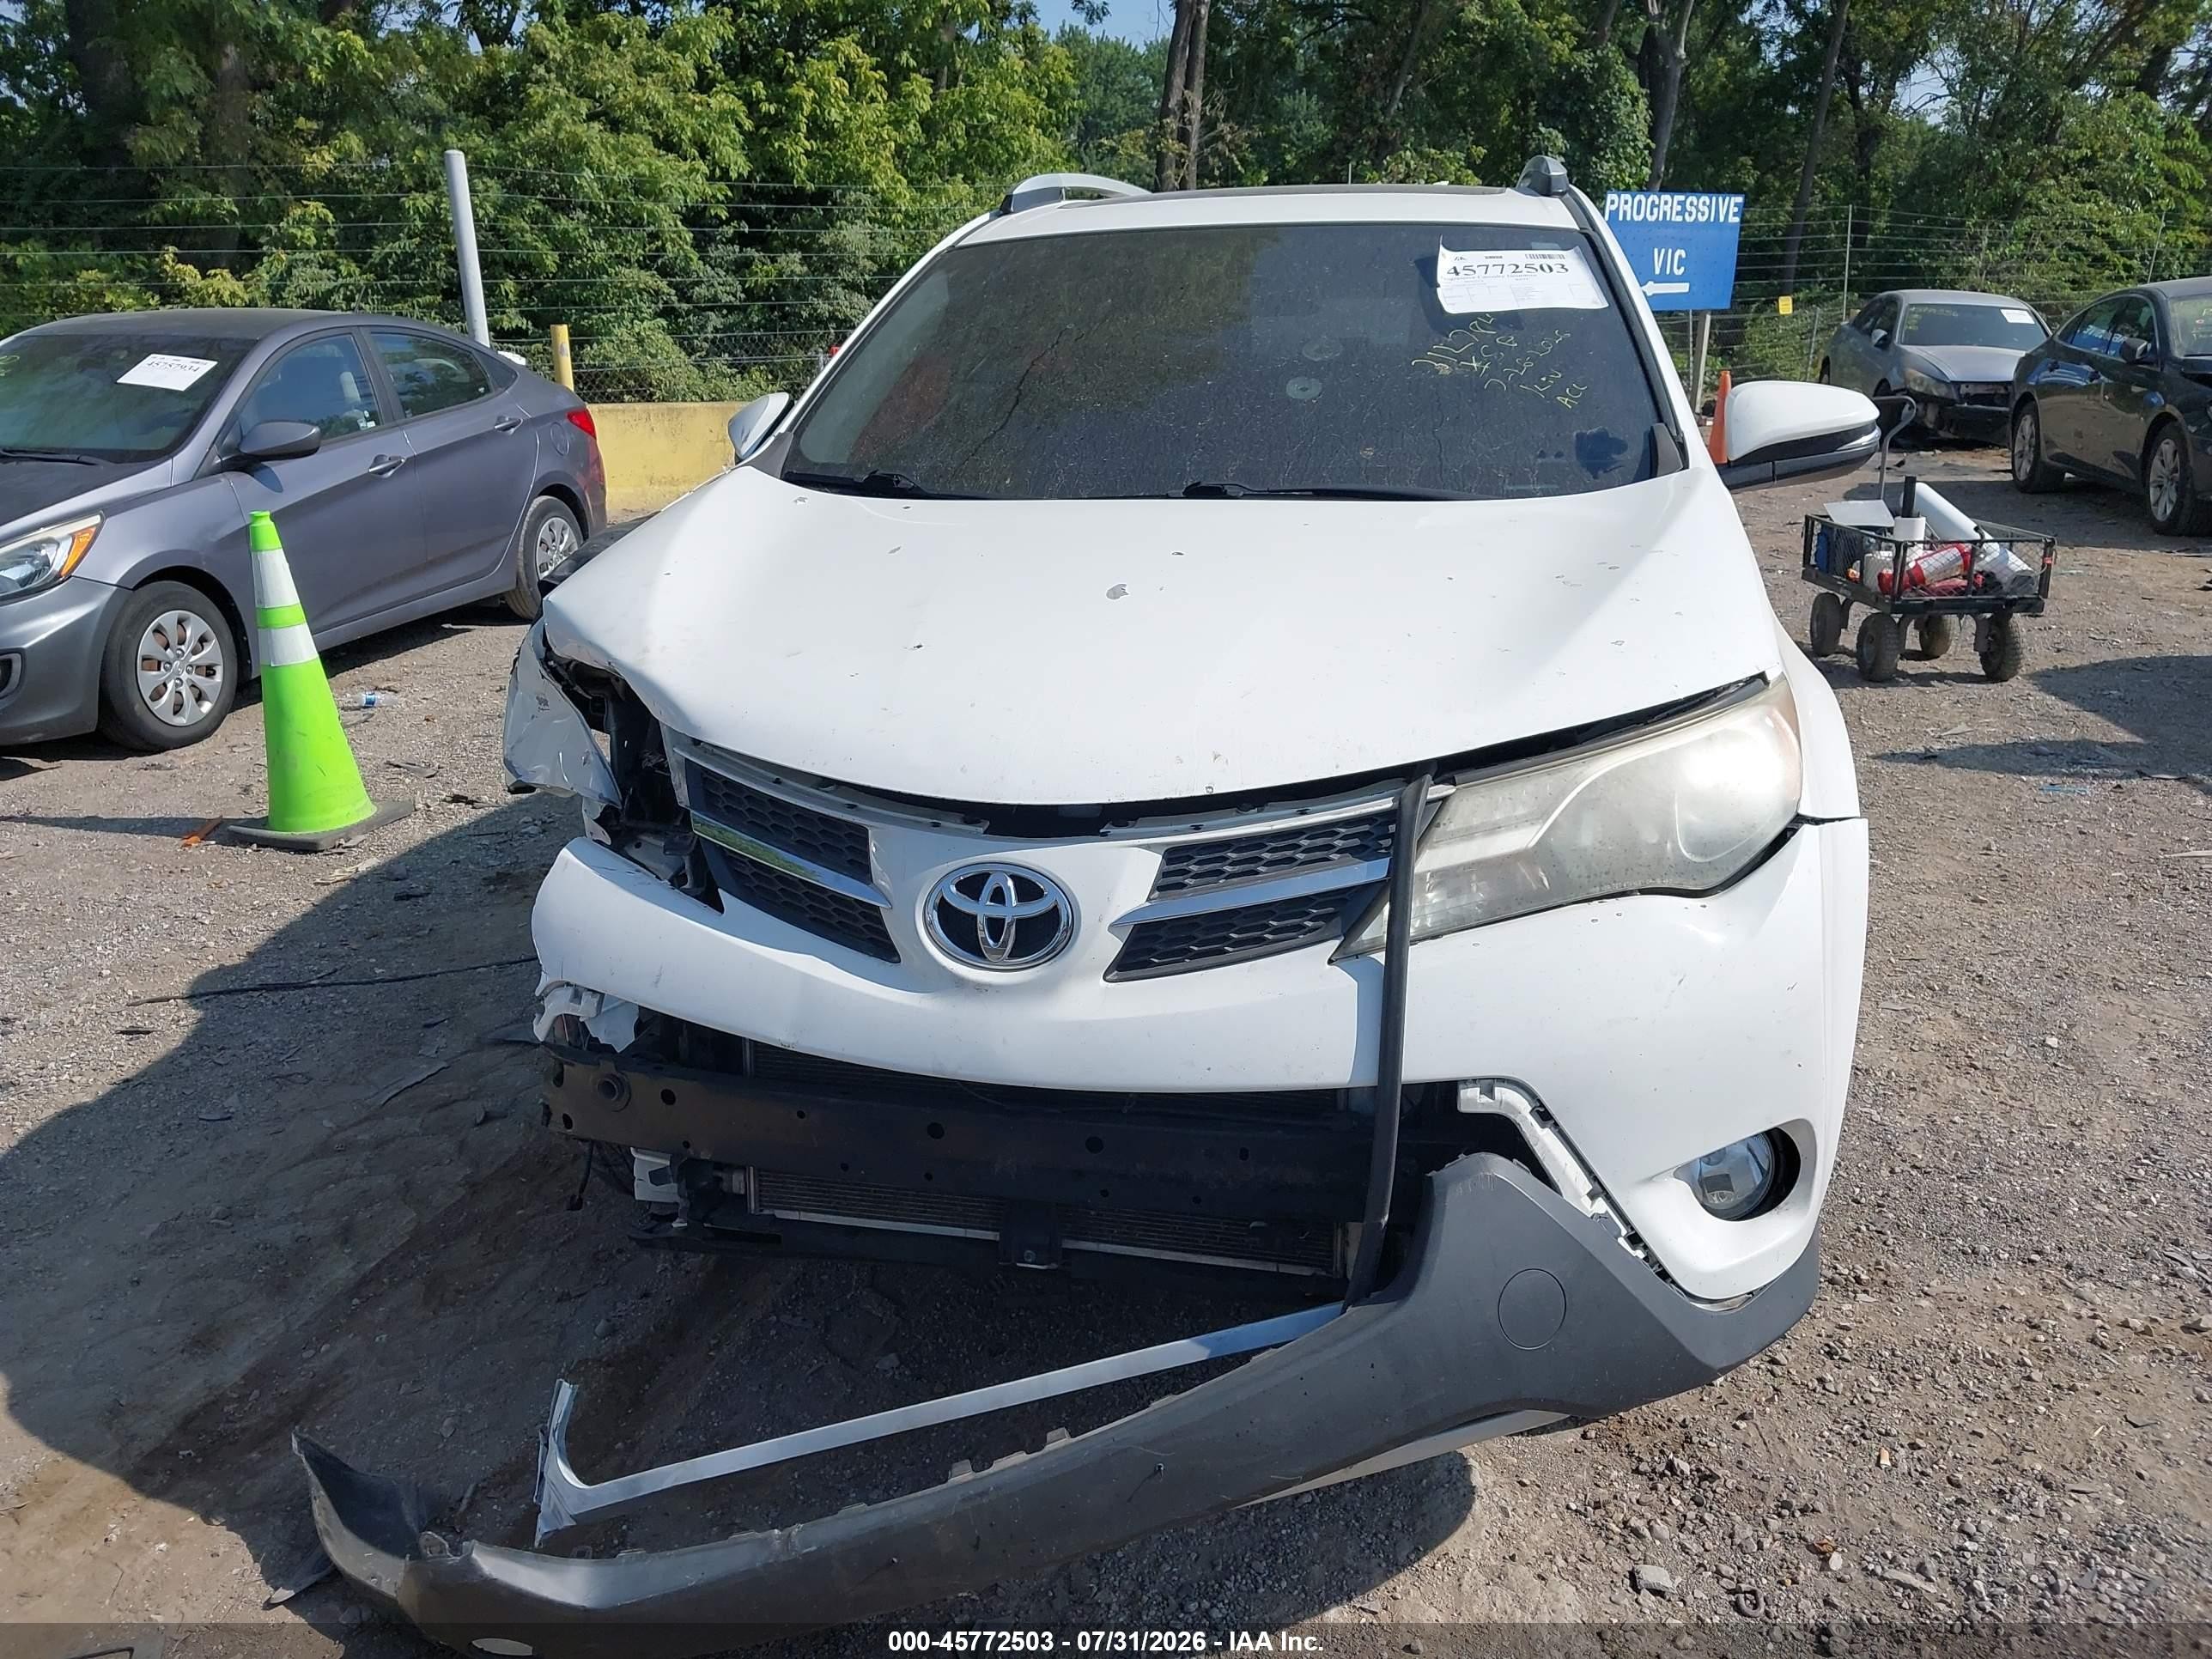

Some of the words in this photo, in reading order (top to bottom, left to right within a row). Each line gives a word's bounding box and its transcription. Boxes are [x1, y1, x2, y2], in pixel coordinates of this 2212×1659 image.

[1604, 193, 1744, 223] PROGRESSIVE
[1446, 262, 1570, 276] 45772503
[1653, 247, 1686, 276] VIC
